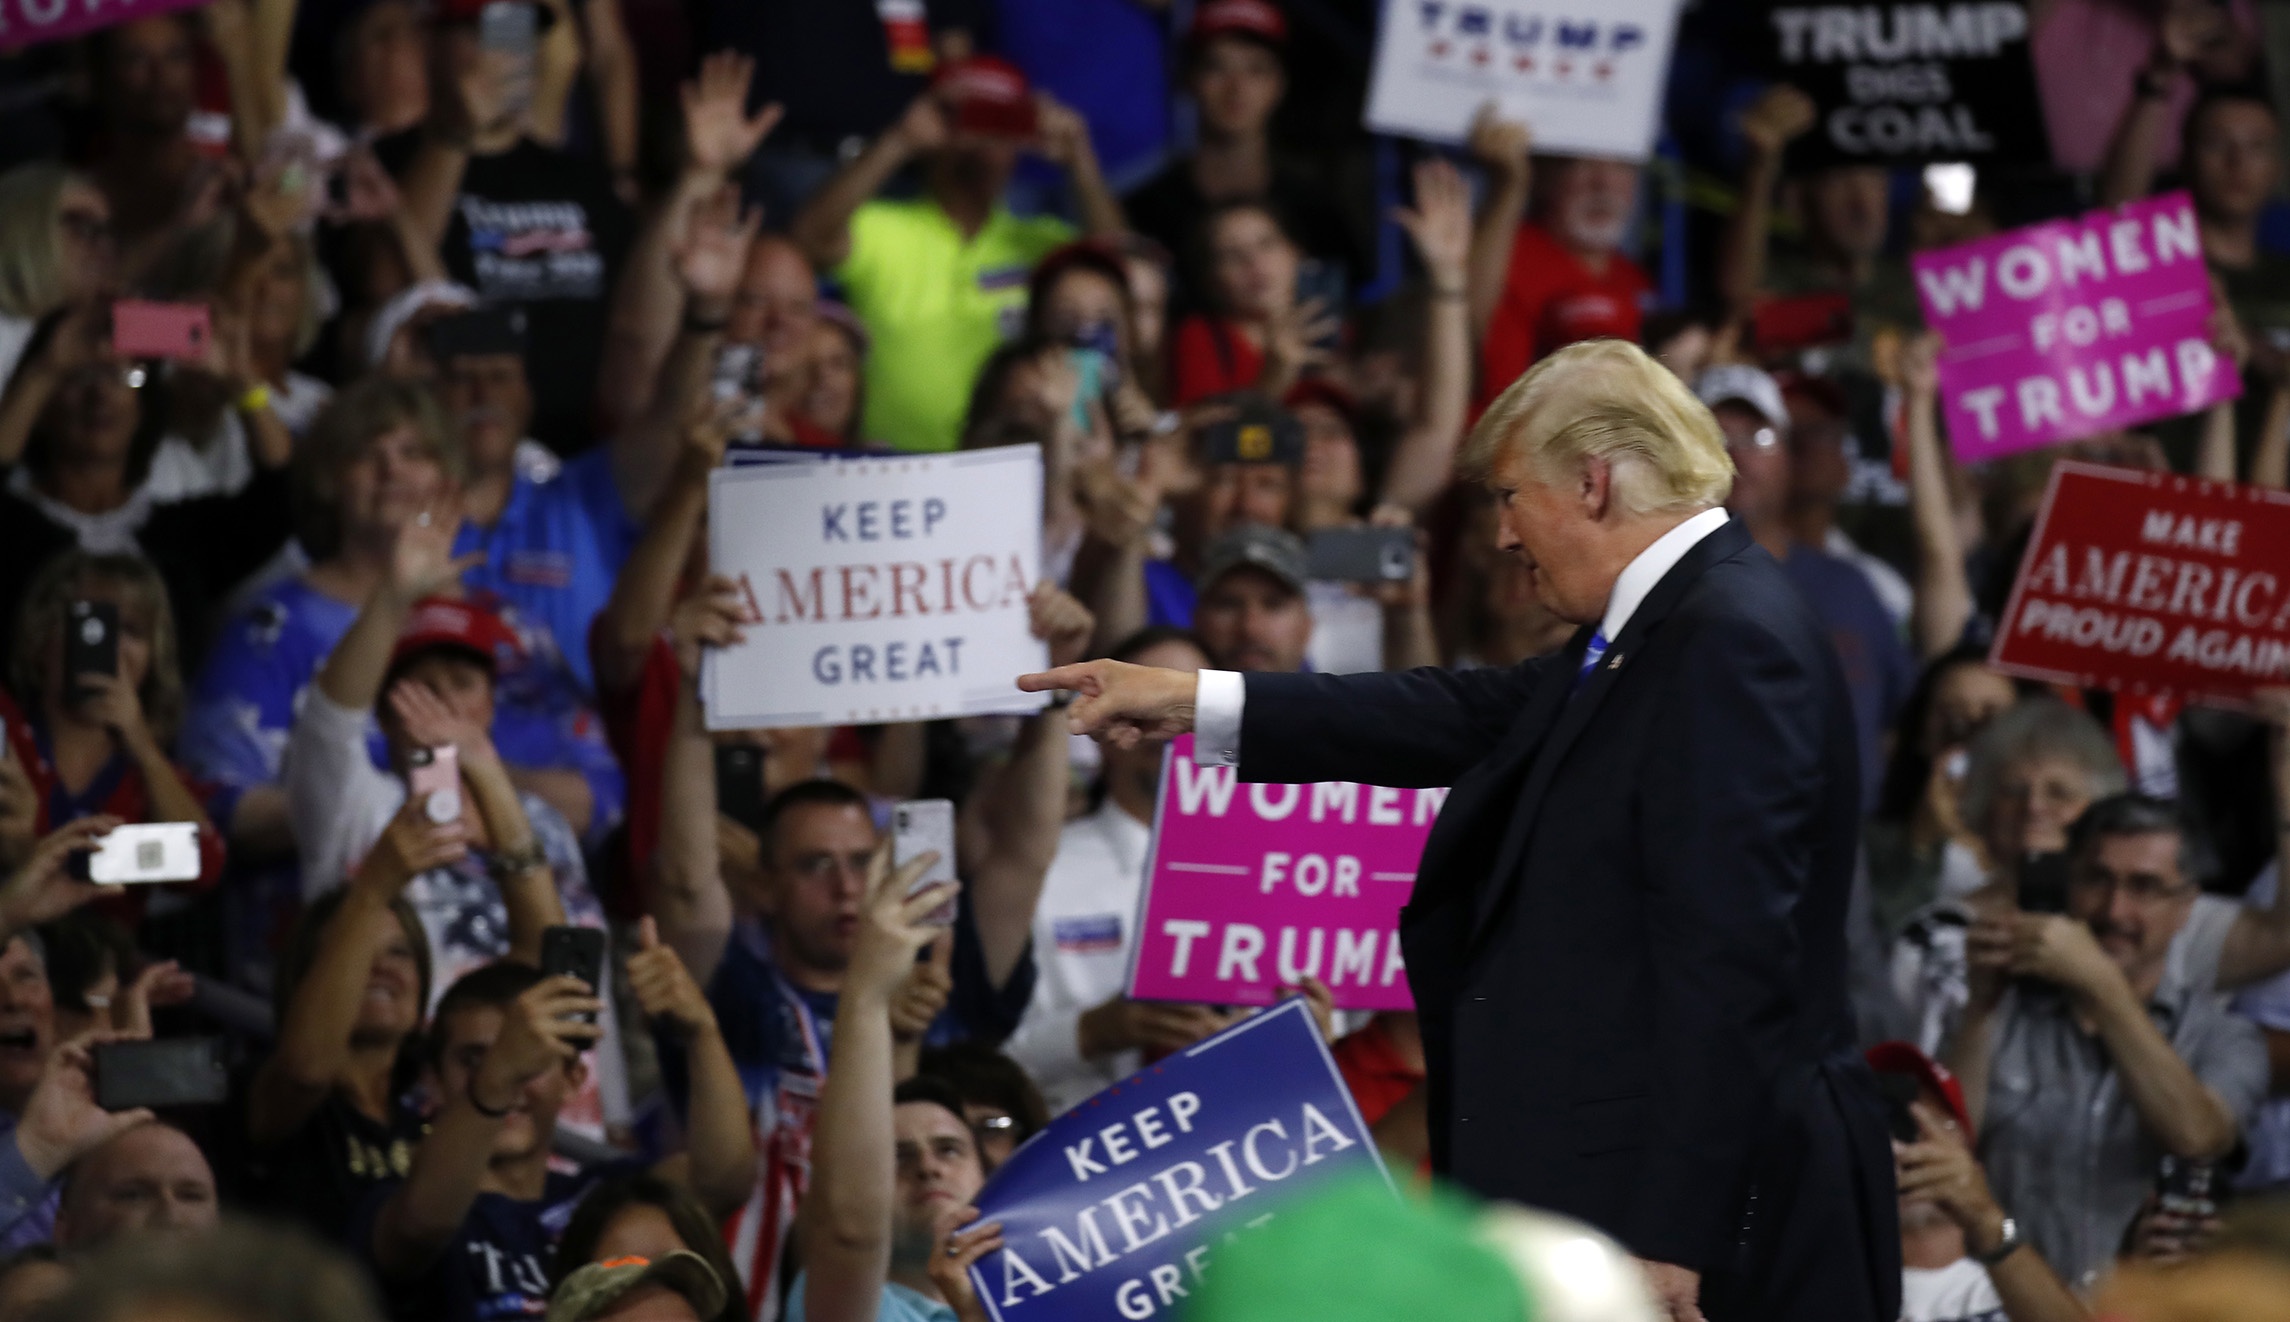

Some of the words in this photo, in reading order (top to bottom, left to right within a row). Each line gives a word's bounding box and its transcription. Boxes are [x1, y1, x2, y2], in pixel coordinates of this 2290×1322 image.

[1772, 3, 2027, 62] TRUMP
[1829, 105, 1993, 152] COAL
[1919, 206, 2200, 316] WOMEN
[2031, 297, 2132, 354] FOR
[1960, 338, 2215, 441] TRUMP
[822, 497, 946, 542] KEEP
[2142, 509, 2243, 556] MAKE
[2018, 598, 2165, 656] PROUD
[812, 637, 964, 686] GREAT
[1259, 851, 1362, 898] FOR
[1064, 1091, 1200, 1182] KEEP
[1000, 1101, 1357, 1308] AMERICA
